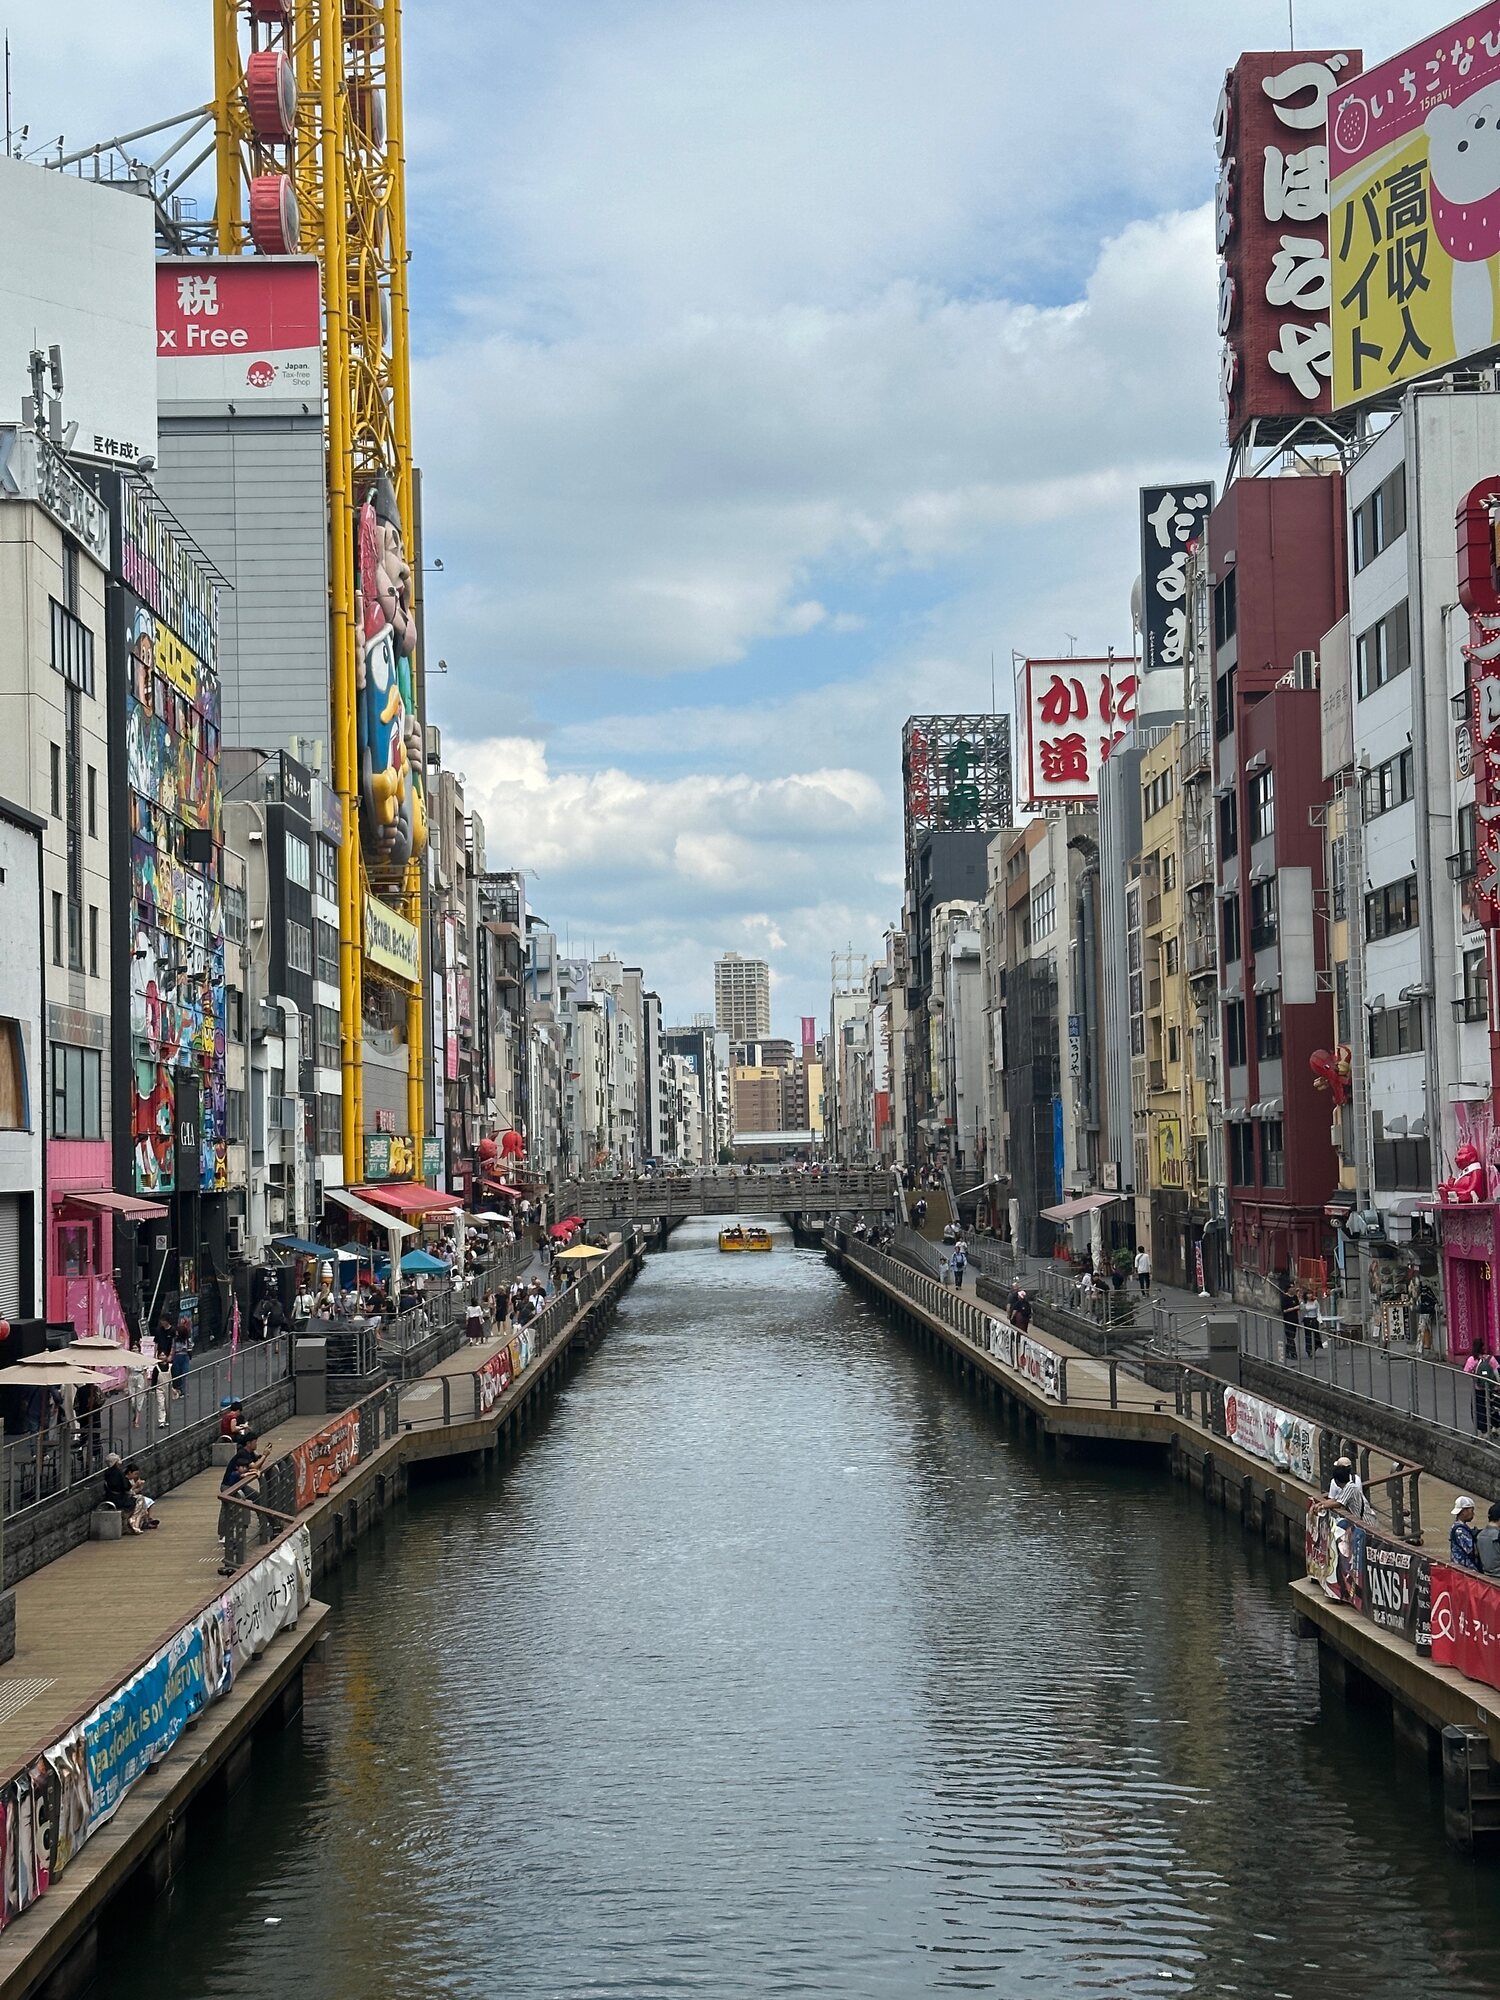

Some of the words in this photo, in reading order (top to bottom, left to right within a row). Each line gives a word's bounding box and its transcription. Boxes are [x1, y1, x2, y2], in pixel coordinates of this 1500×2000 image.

[1420, 84, 1453, 112] 15navi
[1383, 160, 1432, 375] 高収入
[177, 275, 219, 316] 税
[1338, 181, 1384, 391] バイト
[156, 329, 177, 348] x
[186, 324, 249, 348] Free
[282, 371, 311, 379] Tax-free
[292, 379, 311, 387] Shop
[1147, 491, 1208, 663] だるま
[155, 617, 197, 701] 2025
[1037, 673, 1141, 726] かに
[370, 1139, 388, 1158] 薬
[424, 1142, 440, 1158] 薬
